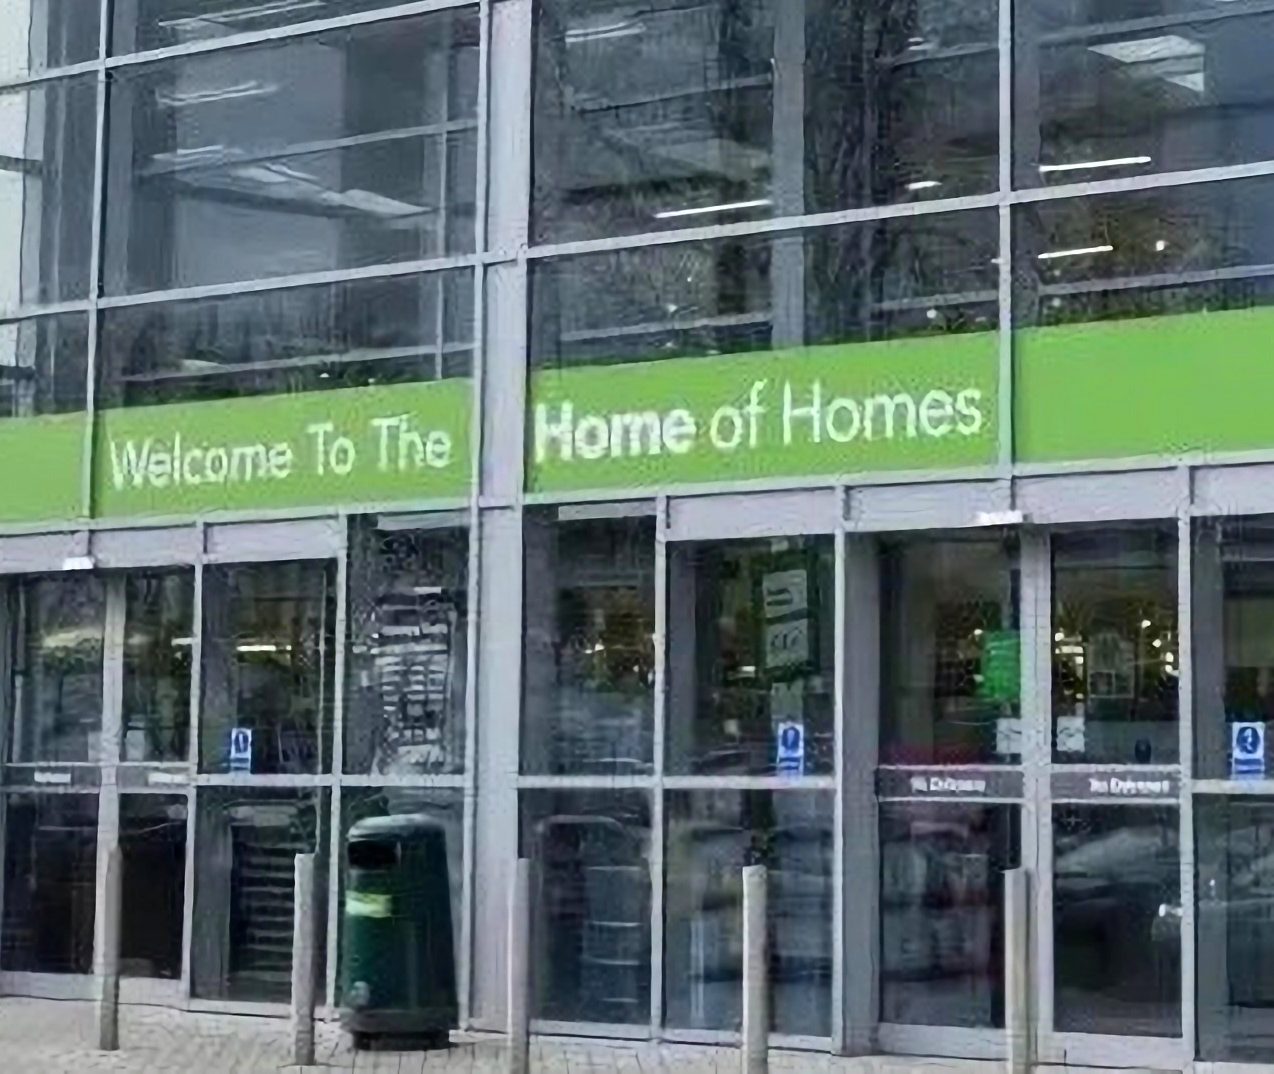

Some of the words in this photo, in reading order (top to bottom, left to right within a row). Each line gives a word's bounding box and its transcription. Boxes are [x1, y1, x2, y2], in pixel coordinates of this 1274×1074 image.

[109, 431, 292, 491] Welcome
[307, 422, 356, 476] To
[370, 412, 452, 472] The
[534, 399, 699, 463] Home
[709, 379, 765, 449] of
[782, 379, 982, 444] Homes
